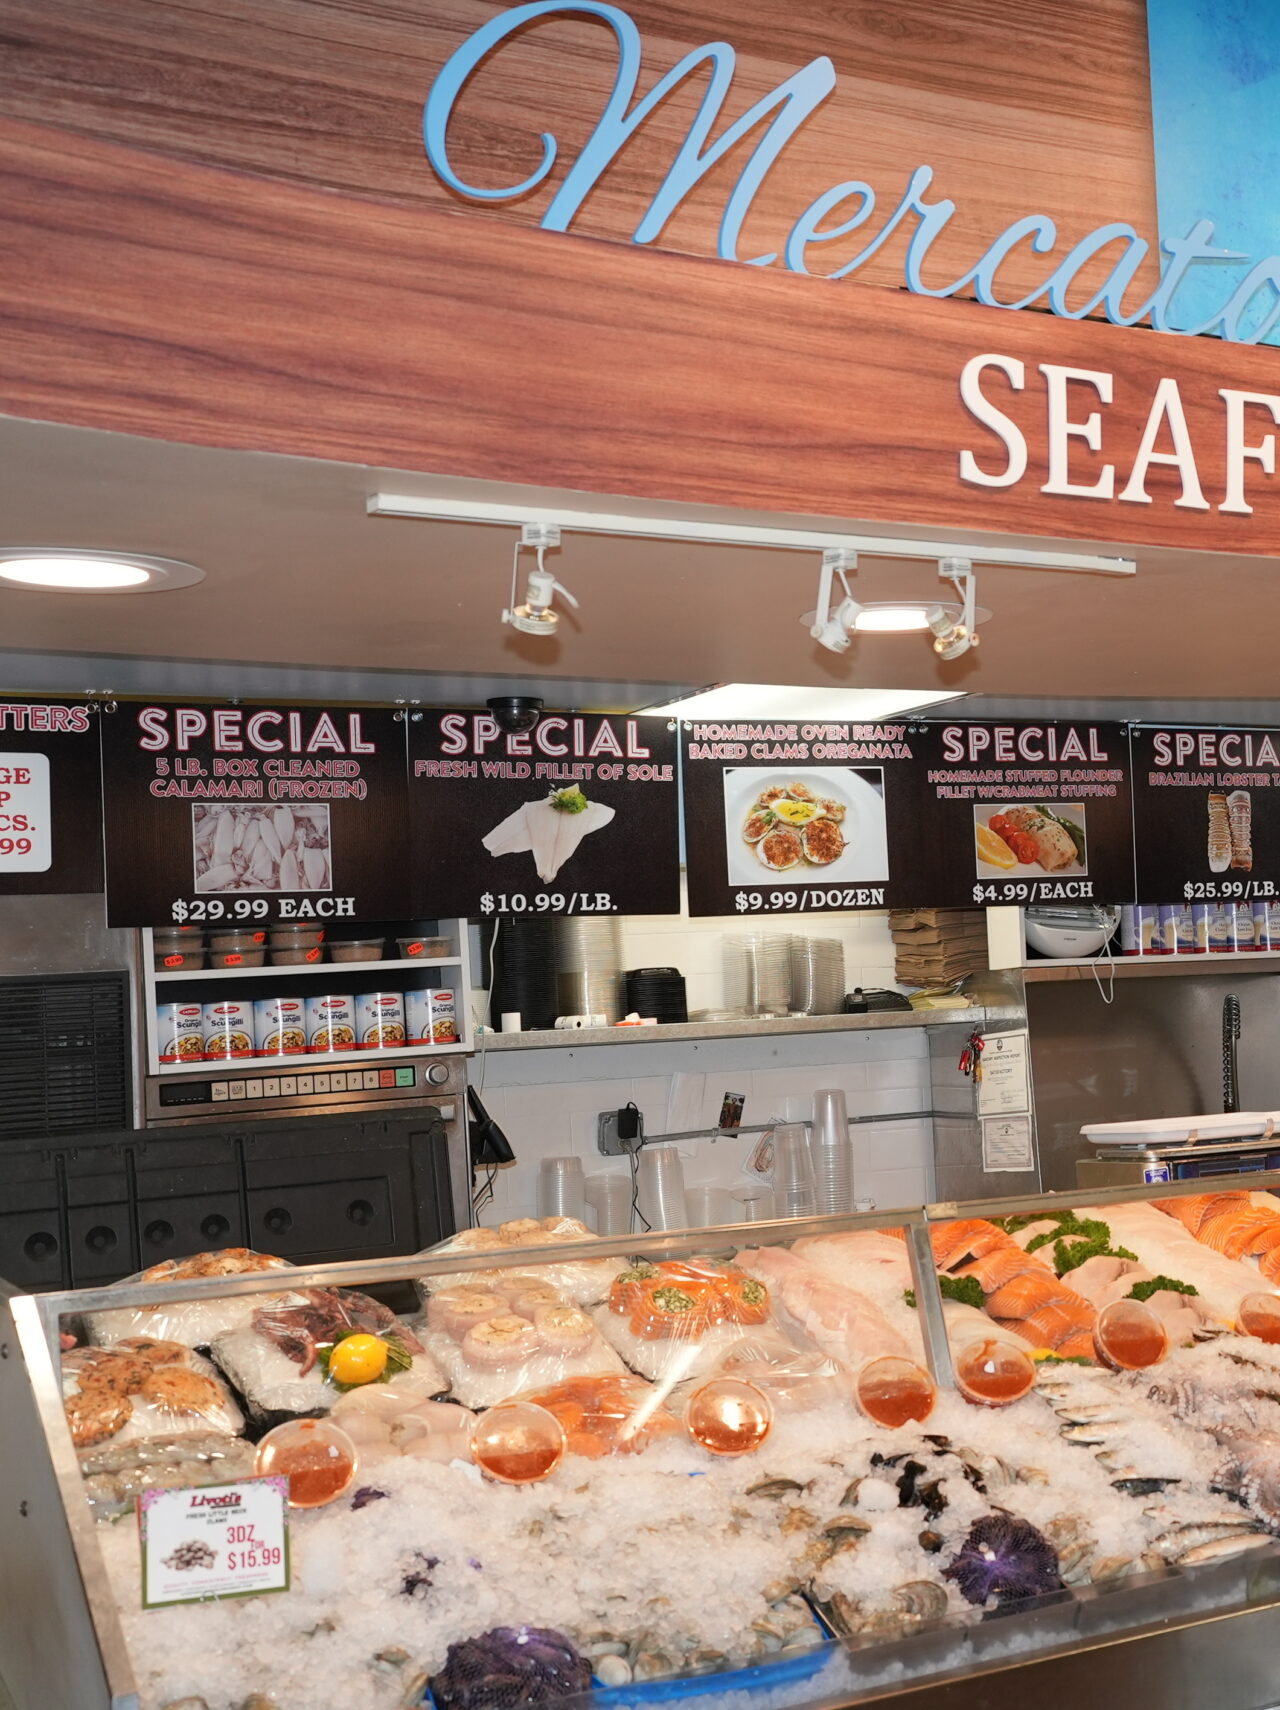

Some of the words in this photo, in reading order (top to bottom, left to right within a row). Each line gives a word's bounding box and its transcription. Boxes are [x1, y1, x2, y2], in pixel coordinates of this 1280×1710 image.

[138, 707, 375, 753] SPECIAL
[440, 713, 651, 759] SPECIAL
[693, 724, 798, 741] HOMEMADE
[801, 724, 849, 741] OVEN
[852, 725, 906, 741] READY
[688, 743, 748, 760] BAKED
[750, 743, 810, 760] CLAMS
[811, 743, 913, 759] OREGANATA
[942, 727, 1108, 762] SPECIAL
[155, 757, 169, 776] 5
[175, 758, 208, 776] LB.
[213, 758, 258, 777] BOX
[262, 759, 361, 778] CLEANED
[414, 760, 477, 778] FRESH
[481, 760, 531, 779] WILD
[535, 761, 595, 780] FILLET
[597, 763, 624, 781] OF
[627, 764, 674, 782] SOLE
[928, 770, 1003, 783] HOMEMADE
[1005, 769, 1058, 782] STUFFED
[1060, 769, 1124, 782] FLOUNDER
[150, 779, 263, 799] CALAMARI
[268, 778, 368, 800] (FROZEN)
[1148, 771, 1215, 787] BRAZILIAN
[1216, 772, 1271, 787] LOBSTER
[936, 785, 976, 798] FILLET
[977, 785, 1058, 798] W/CRABMEAT
[1060, 784, 1117, 797] STUFFING
[735, 888, 885, 912] $9.99/DOZEN
[972, 882, 1094, 903] $4.99/EACH
[1183, 881, 1280, 900] $25.99/LB.
[171, 898, 269, 923] $29.99
[278, 897, 356, 918] EACH
[480, 893, 618, 915] $10.99/LB.
[272, 1014, 301, 1024] Sungilli
[371, 1009, 400, 1018] Sungilli
[227, 1525, 255, 1544] 3DZ
[251, 1540, 264, 1550] FOR
[228, 1547, 281, 1570] $15.99
